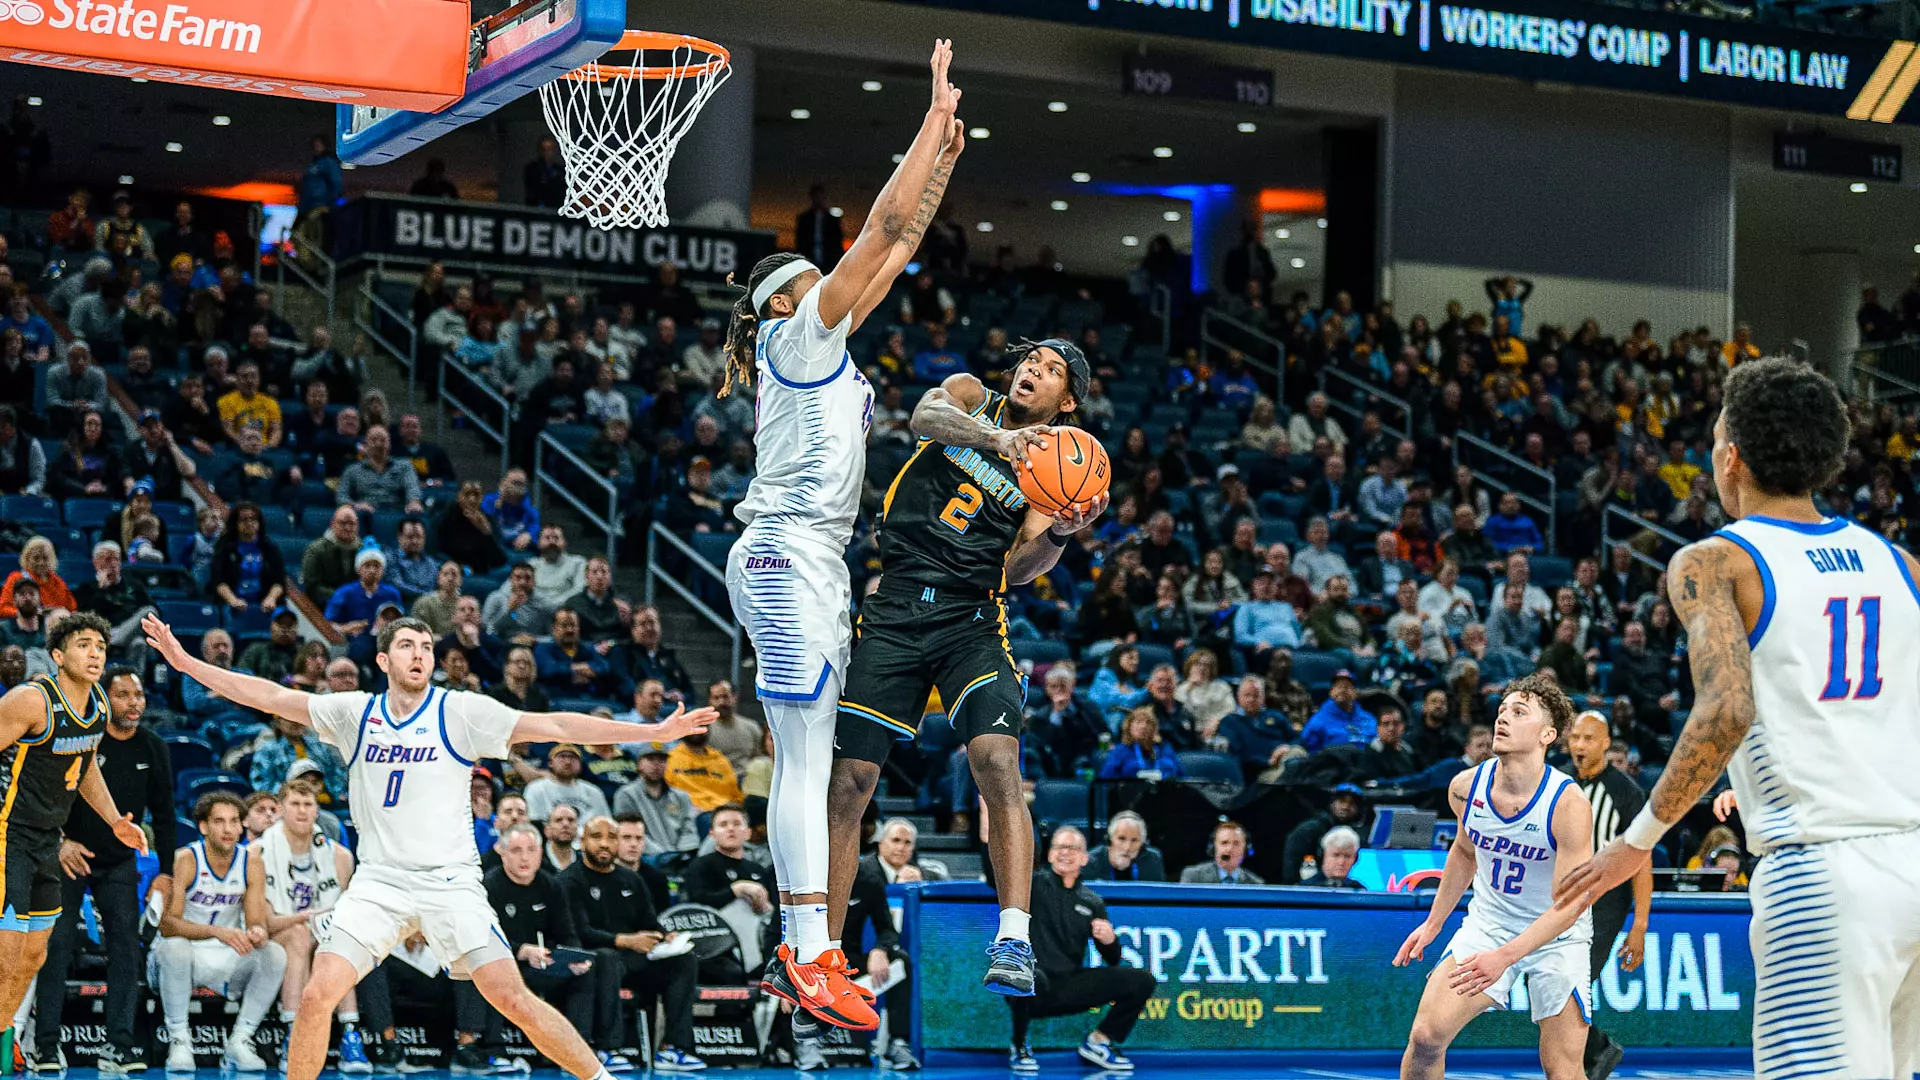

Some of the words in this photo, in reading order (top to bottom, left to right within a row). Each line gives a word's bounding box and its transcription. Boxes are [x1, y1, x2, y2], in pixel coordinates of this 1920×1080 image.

[1250, 0, 1413, 37] DISABILITY
[1588, 23, 1671, 68] COMP
[1699, 37, 1787, 84] LABOR
[1789, 49, 1850, 90] LAW
[1131, 68, 1173, 95] 109
[1235, 80, 1269, 106] 110
[1783, 144, 1807, 168] 111
[1871, 154, 1899, 176] 112
[395, 209, 497, 252] BLUE
[503, 220, 637, 265] DEMON
[643, 233, 738, 273] CLUB
[939, 482, 984, 535] 2
[1804, 547, 1865, 574] GUNN
[920, 586, 936, 603] AL
[1817, 595, 1884, 703] 11
[64, 755, 83, 791] 4
[382, 769, 405, 808] 0
[1490, 857, 1526, 895] 12
[673, 912, 717, 930] RUSH
[1176, 990, 1264, 1028] Group
[692, 1026, 744, 1044] RUSH
